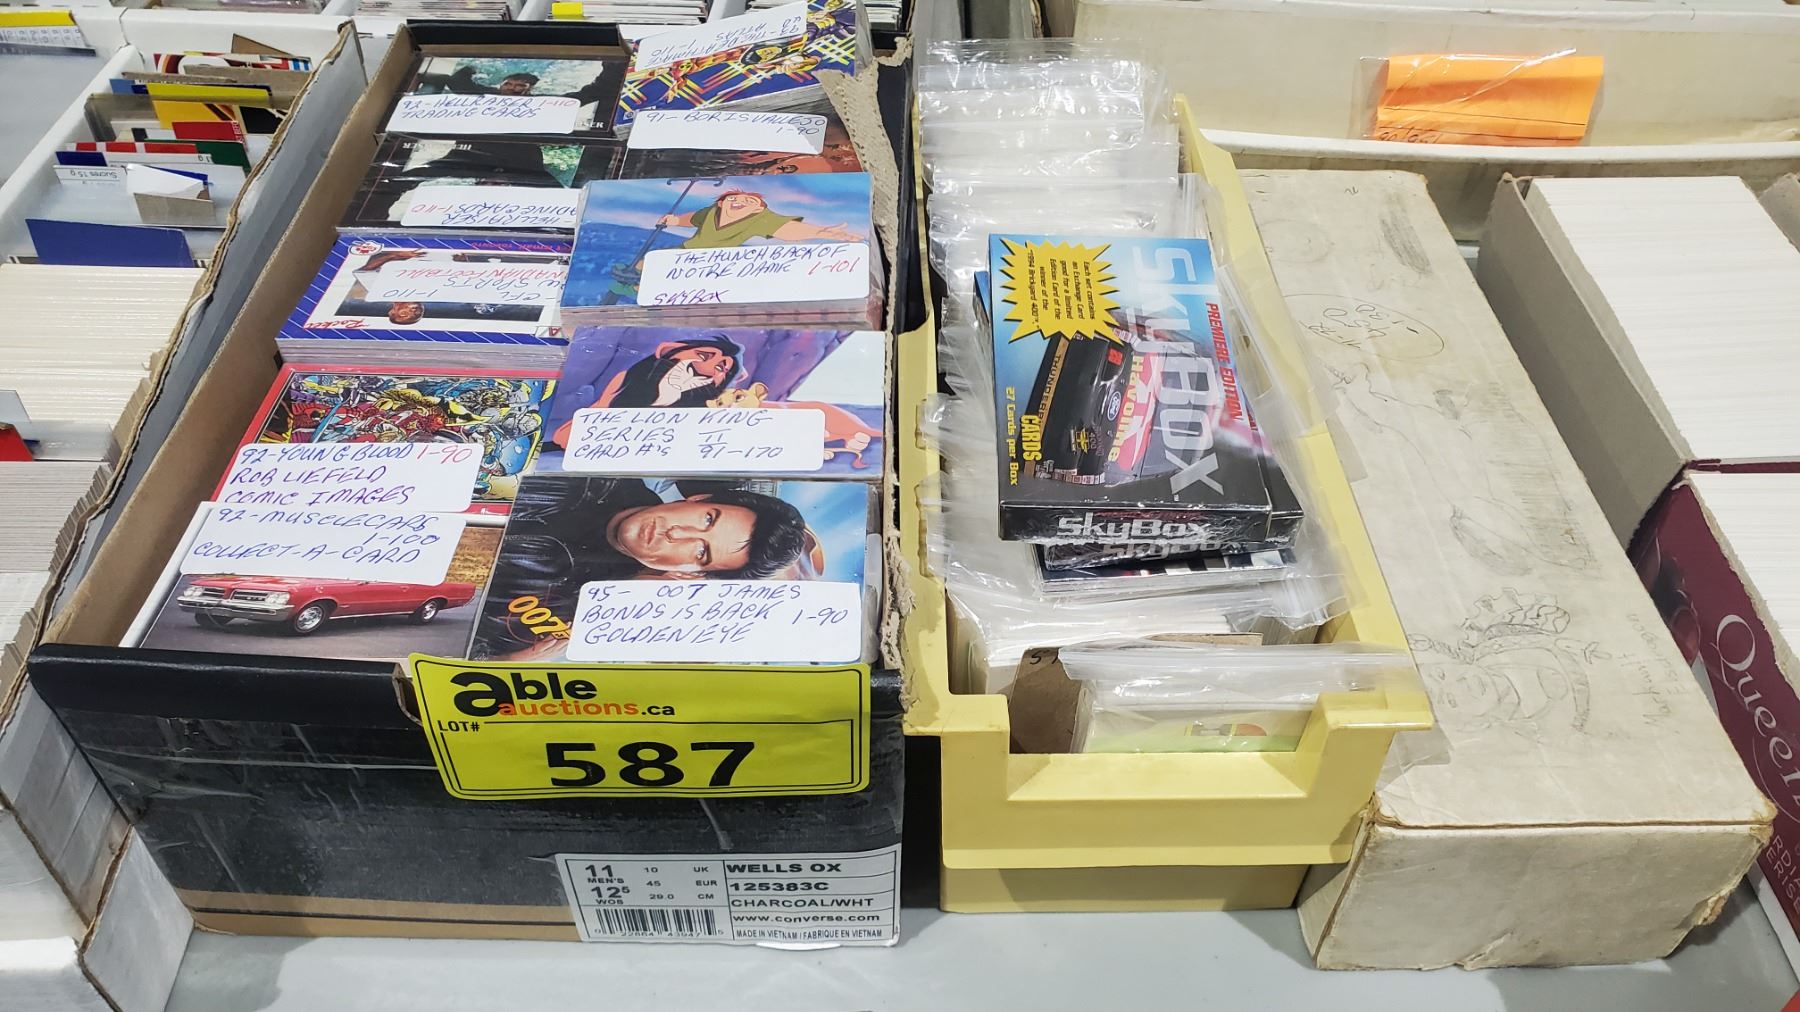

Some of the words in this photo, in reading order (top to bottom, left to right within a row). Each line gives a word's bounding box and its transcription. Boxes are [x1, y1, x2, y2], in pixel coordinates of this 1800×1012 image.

[666, 264, 734, 280] NOTRE
[1205, 302, 1232, 364] PREMIERE
[579, 412, 623, 424] THE
[630, 411, 688, 425] LION
[697, 409, 774, 426] KING
[581, 428, 676, 443] SERIES
[1020, 414, 1042, 461] CARDS
[574, 445, 631, 459] CARD
[699, 446, 784, 459] 91-170
[230, 466, 273, 486] ROB
[1009, 462, 1019, 486] Box
[224, 490, 301, 506] COMIC
[307, 486, 416, 507] IMAGES
[362, 533, 441, 547] 1-100
[657, 584, 706, 599] 007
[717, 583, 802, 600] JAMES
[581, 601, 663, 624] BONDS
[671, 602, 696, 621] IS
[701, 601, 784, 621] BACK
[792, 608, 848, 626] 1-90
[498, 699, 676, 717] auctions.ca
[438, 719, 481, 734] LOT#
[544, 741, 756, 787] 587
[584, 864, 615, 878] 11
[726, 863, 804, 874] WELLS
[810, 863, 843, 873] OX
[695, 879, 718, 887] EUR
[729, 881, 830, 892] 125383C
[730, 898, 875, 908] CHARCOAL/WHT
[732, 913, 881, 924] www.converse.com
[736, 929, 758, 938] MADE
[759, 929, 767, 938] IN
[768, 930, 799, 940] VIETNAM
[804, 930, 840, 940] FABRIQUE
[841, 930, 851, 939] EN
[851, 929, 883, 938] VIETNAM
